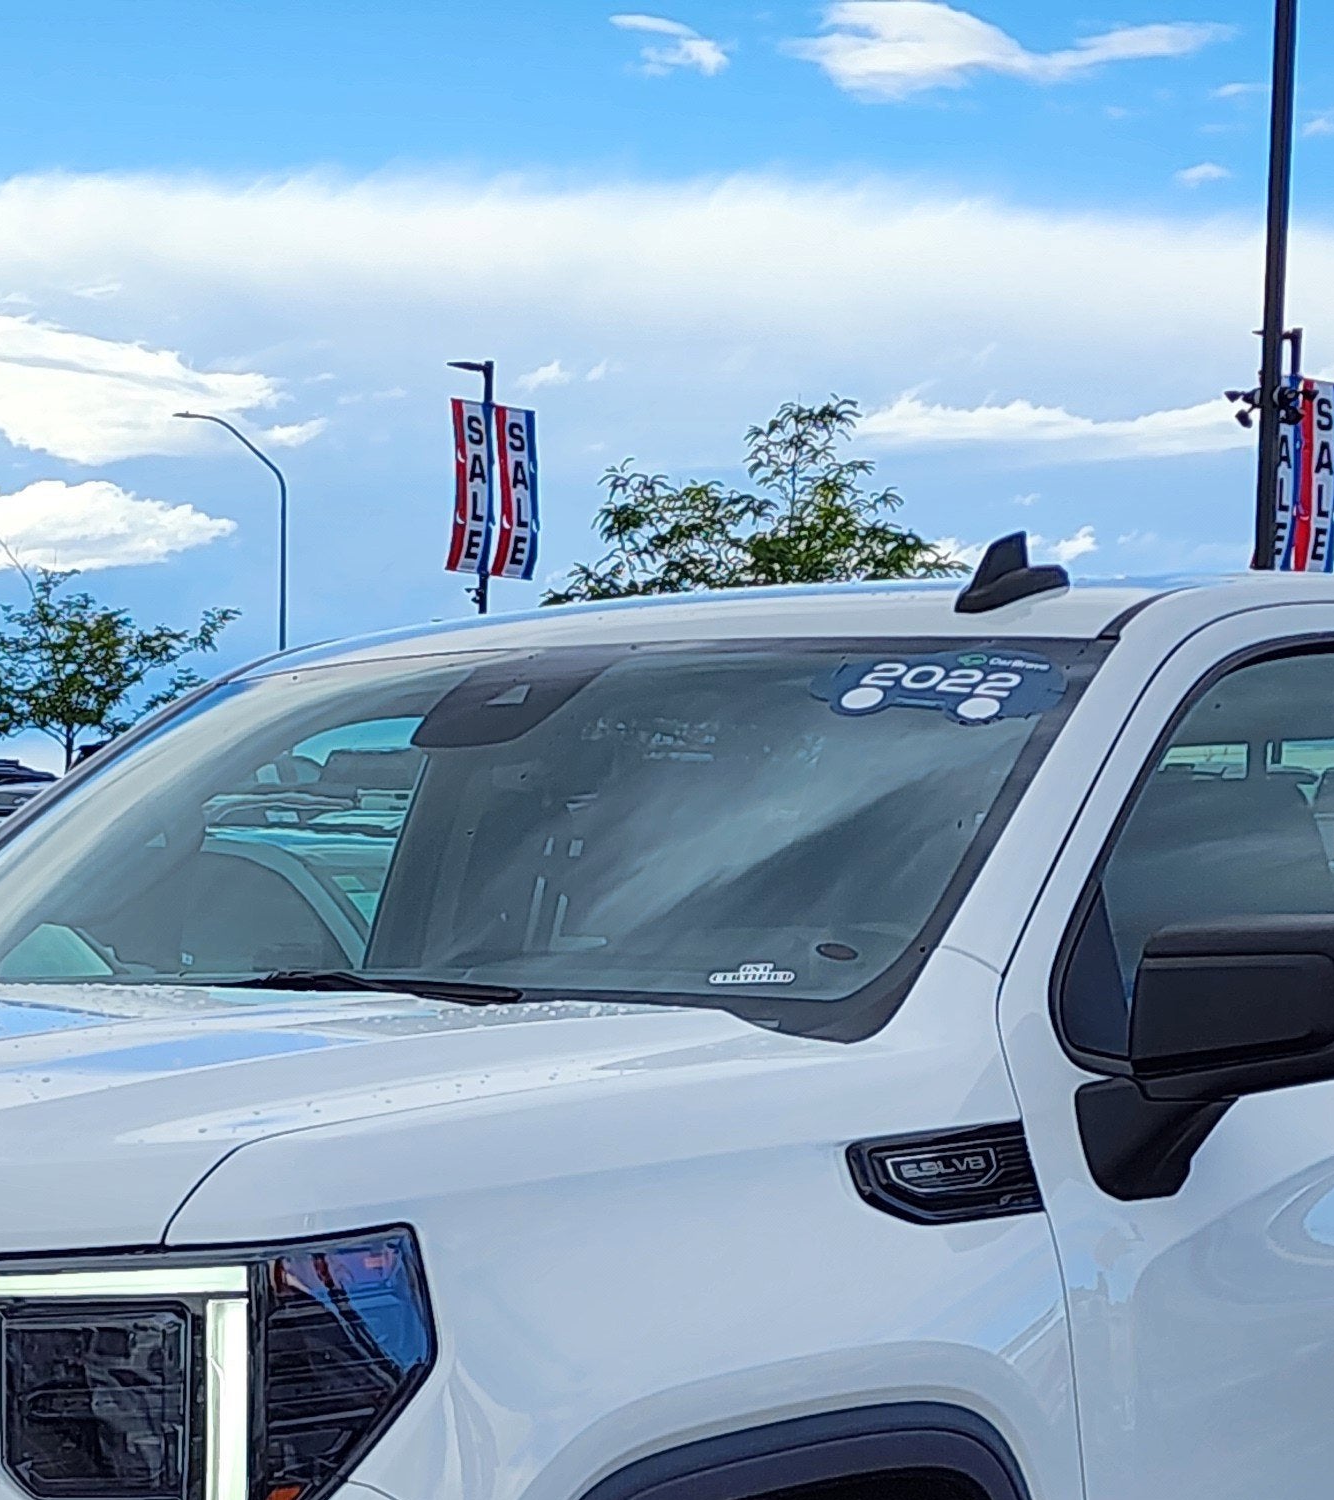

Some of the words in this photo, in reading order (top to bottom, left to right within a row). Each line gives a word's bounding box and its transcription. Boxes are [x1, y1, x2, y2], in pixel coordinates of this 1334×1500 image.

[464, 414, 486, 560] SALE
[508, 422, 529, 566] SALE
[1310, 397, 1334, 561] SALE
[859, 662, 1023, 698] 2022
